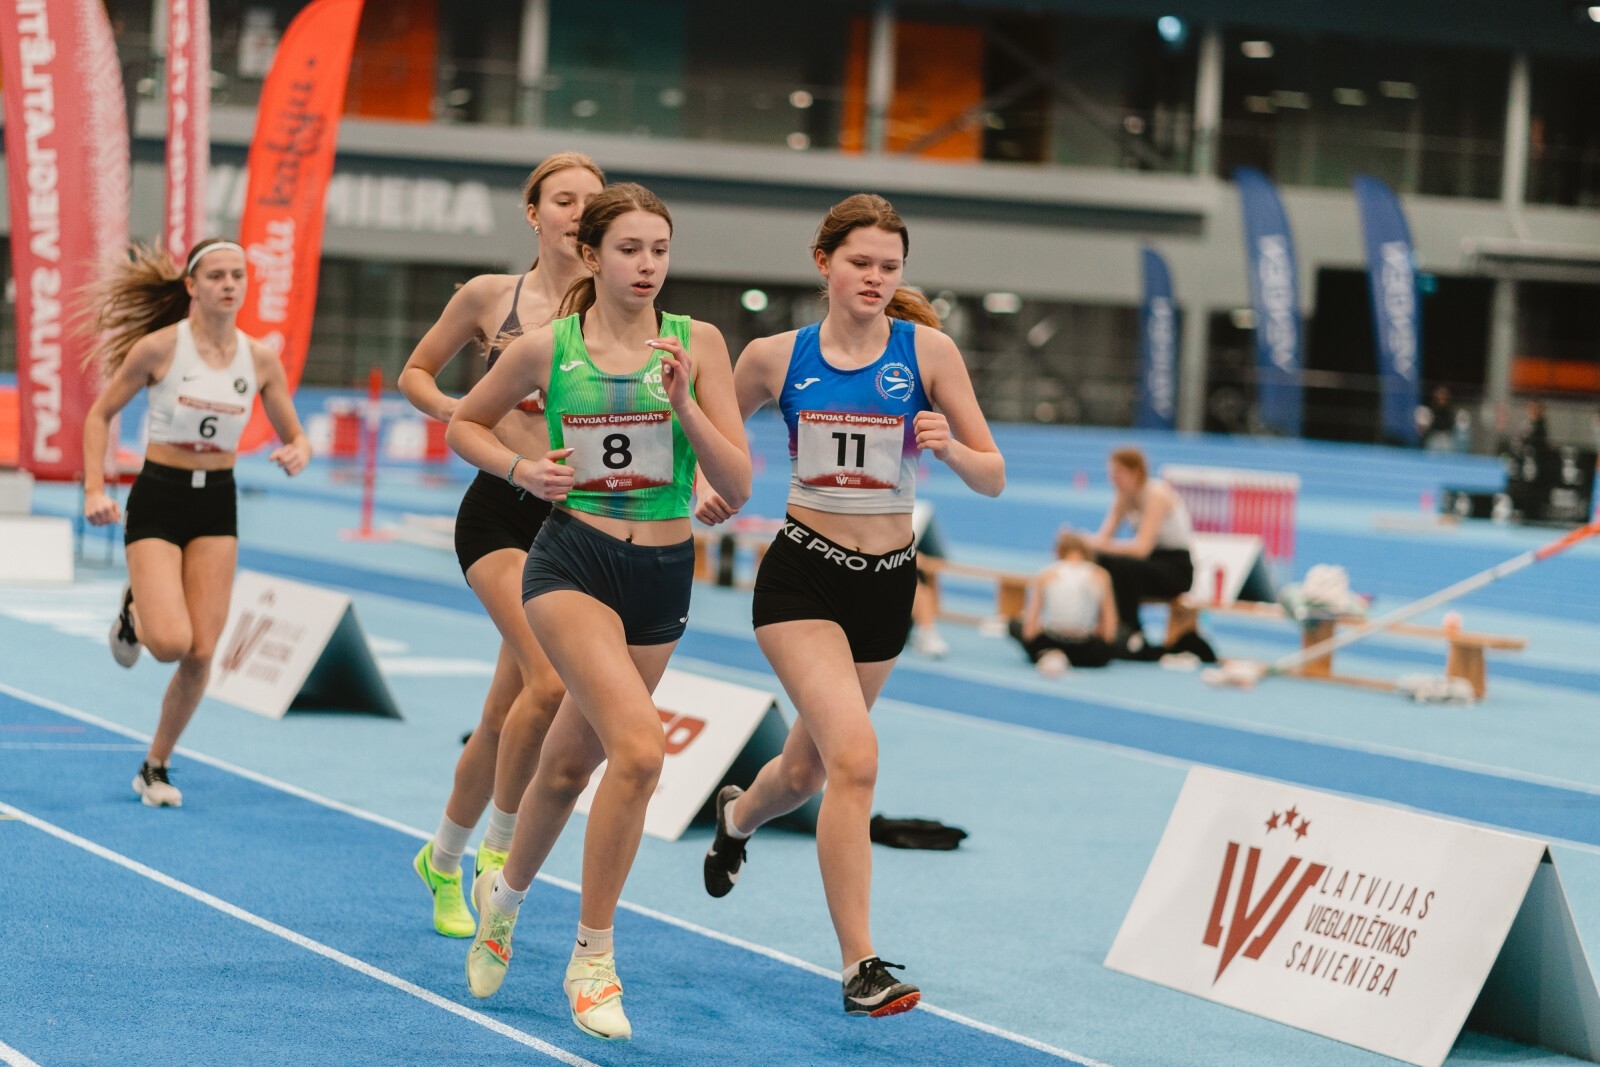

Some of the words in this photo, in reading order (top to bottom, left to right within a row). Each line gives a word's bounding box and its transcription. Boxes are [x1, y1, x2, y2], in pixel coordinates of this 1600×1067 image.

[199, 416, 218, 438] 6
[568, 416, 607, 424] LATVIJAS
[608, 413, 664, 423] ČEMPIONĀTS
[806, 413, 843, 422] LATVIJAS
[845, 413, 898, 425] ČEMPIONĀTS
[602, 433, 633, 470] 8
[832, 432, 866, 468] 11
[806, 537, 868, 571] PRO
[1320, 866, 1435, 920] LATVIJAS
[1304, 903, 1417, 958] VIEGLATLĒTIKAS
[1285, 941, 1399, 997] SAVIENĪBA
